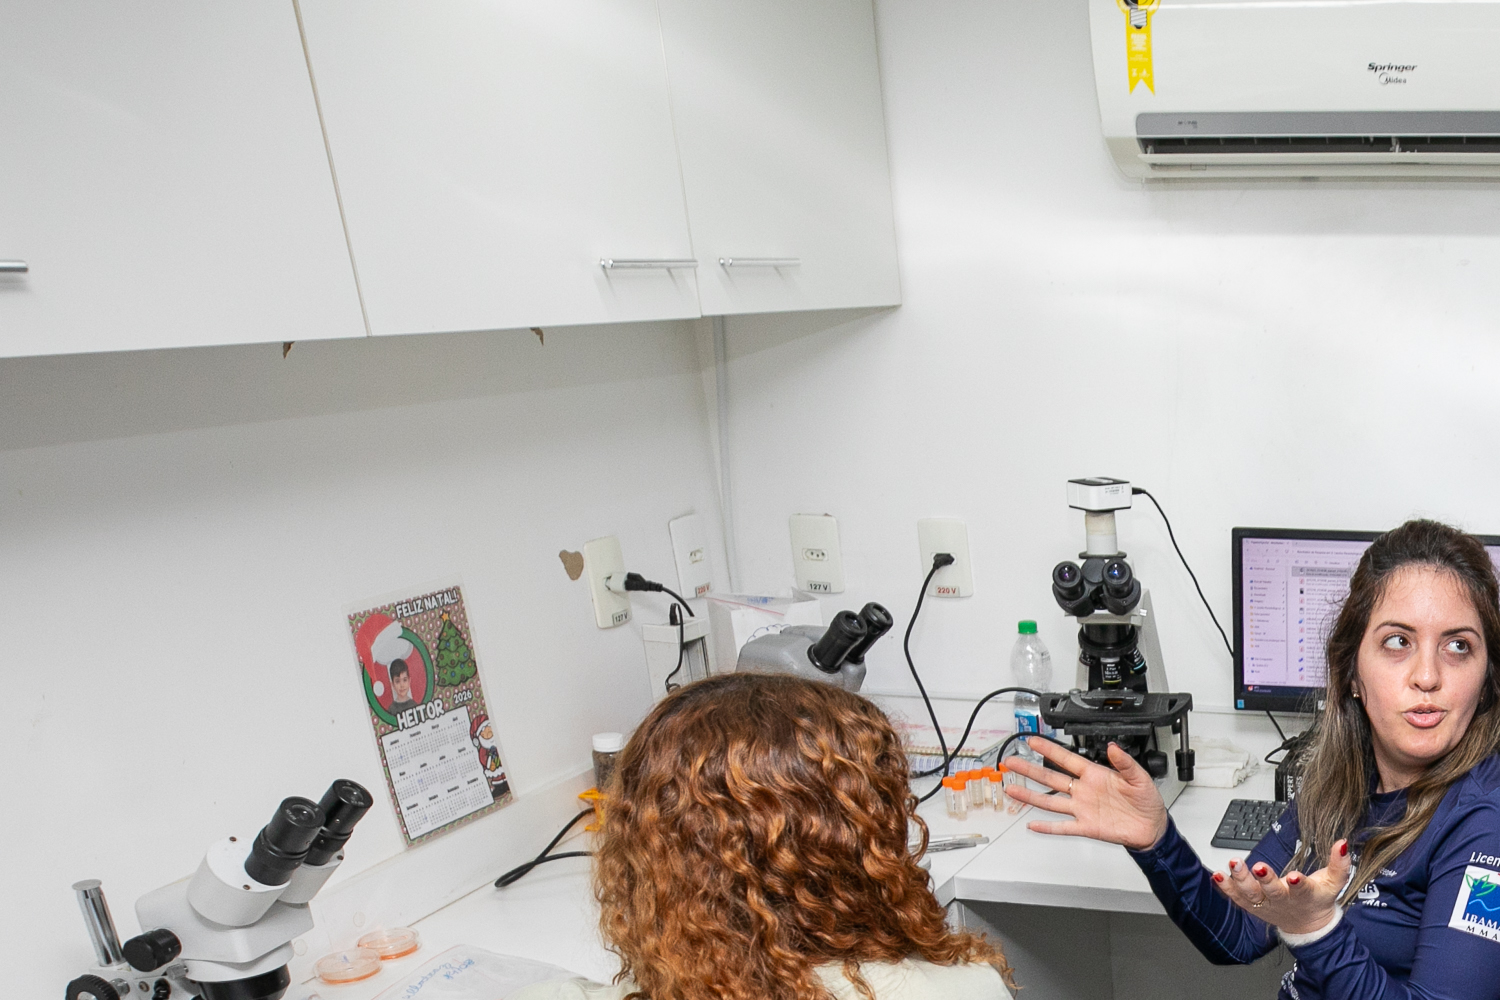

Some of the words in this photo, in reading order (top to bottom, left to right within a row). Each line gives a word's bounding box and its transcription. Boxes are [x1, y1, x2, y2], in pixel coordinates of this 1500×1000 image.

[1367, 62, 1418, 73] Springer
[1382, 74, 1407, 84] Midea
[395, 600, 424, 619] FELIZ
[424, 590, 458, 610] NATAL!
[614, 614, 624, 623] 127
[453, 690, 472, 704] 2026
[397, 698, 445, 731] HEITOR
